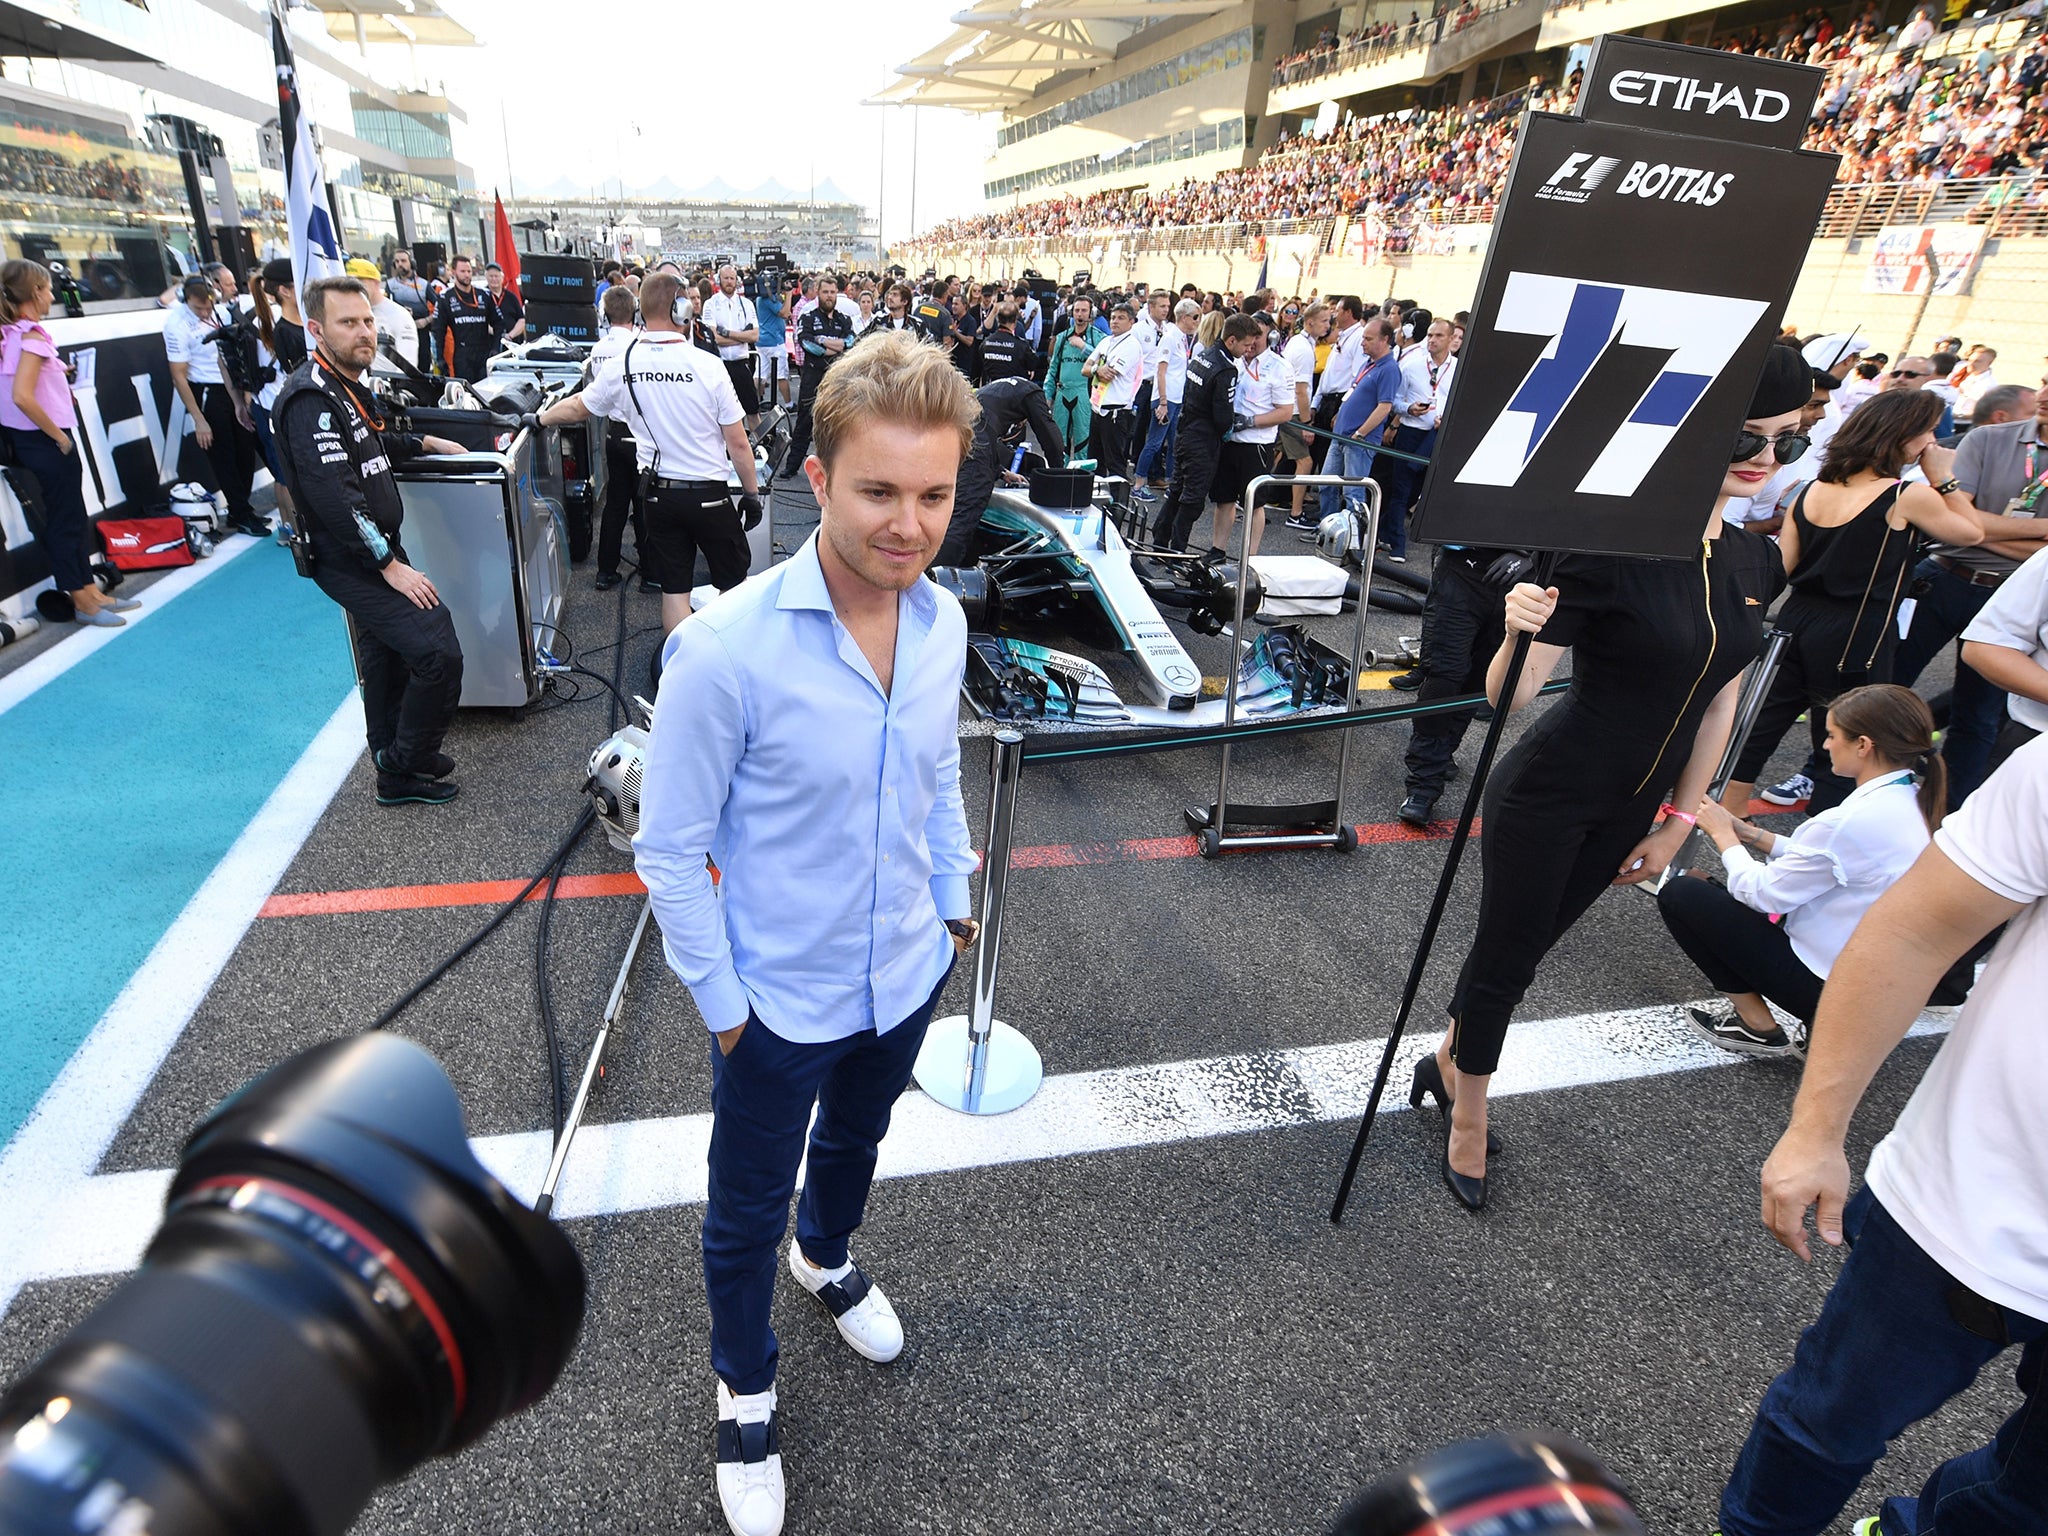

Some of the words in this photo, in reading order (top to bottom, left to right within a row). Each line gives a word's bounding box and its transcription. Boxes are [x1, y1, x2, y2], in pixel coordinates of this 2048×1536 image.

[1609, 70, 1791, 123] ETIHAD
[1616, 161, 1735, 206] BOTTAS
[1538, 185, 1554, 194] FIA
[1553, 188, 1585, 198] Formula
[543, 275, 561, 285] LEFT
[562, 276, 584, 287] FRONT
[454, 316, 486, 324] PETRONAS
[548, 325, 566, 336] LEFT
[568, 327, 588, 337] REAR
[984, 352, 1013, 362] PETRONAS
[622, 371, 694, 384] PETRONAS
[1454, 271, 1772, 498] 77
[1048, 654, 1090, 670] PETRONAS
